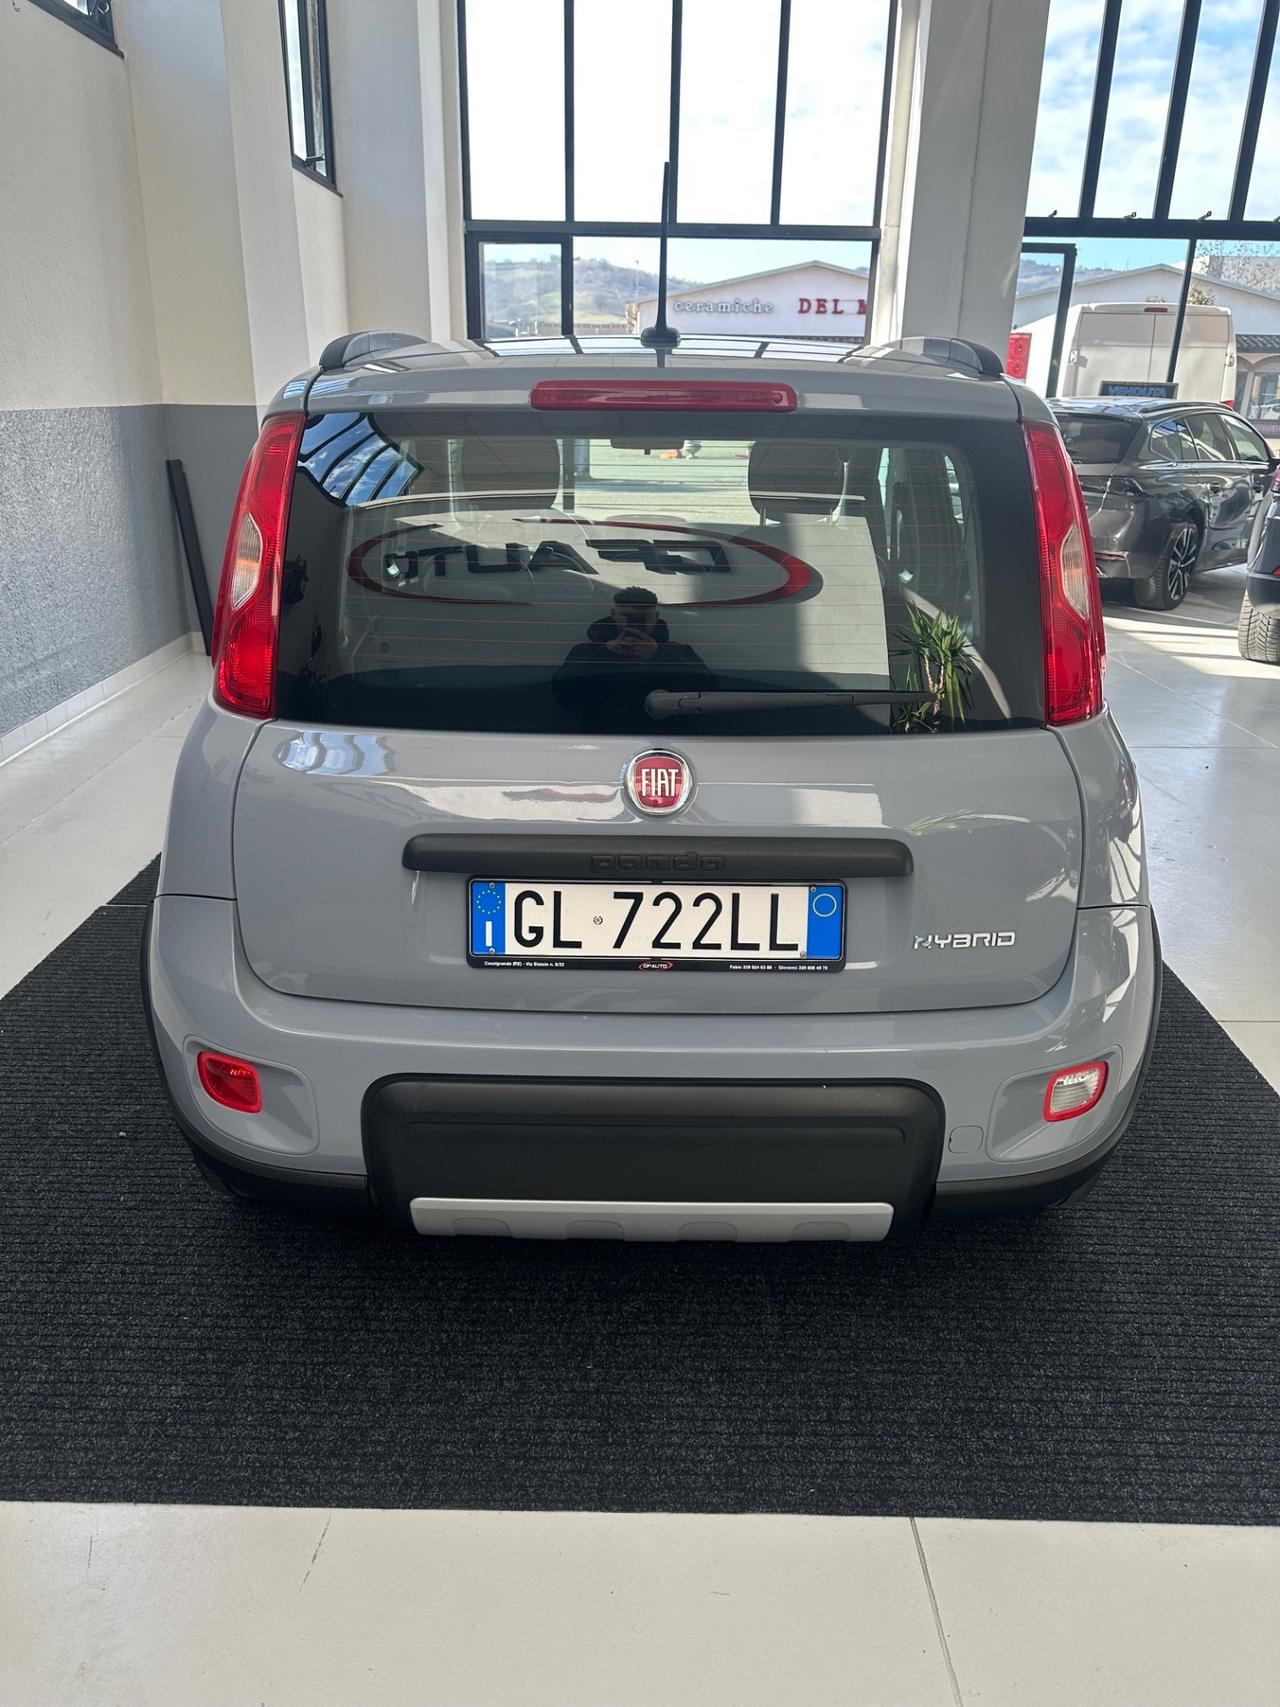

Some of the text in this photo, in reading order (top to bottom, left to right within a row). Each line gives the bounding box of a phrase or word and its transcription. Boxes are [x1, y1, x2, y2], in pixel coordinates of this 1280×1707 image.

[673, 298, 774, 314] ceramiche
[798, 298, 844, 315] DEL
[641, 768, 679, 798] FIAT
[591, 851, 725, 874] panda
[513, 890, 799, 951] GL 722LL
[913, 931, 1016, 950] HYBRID
